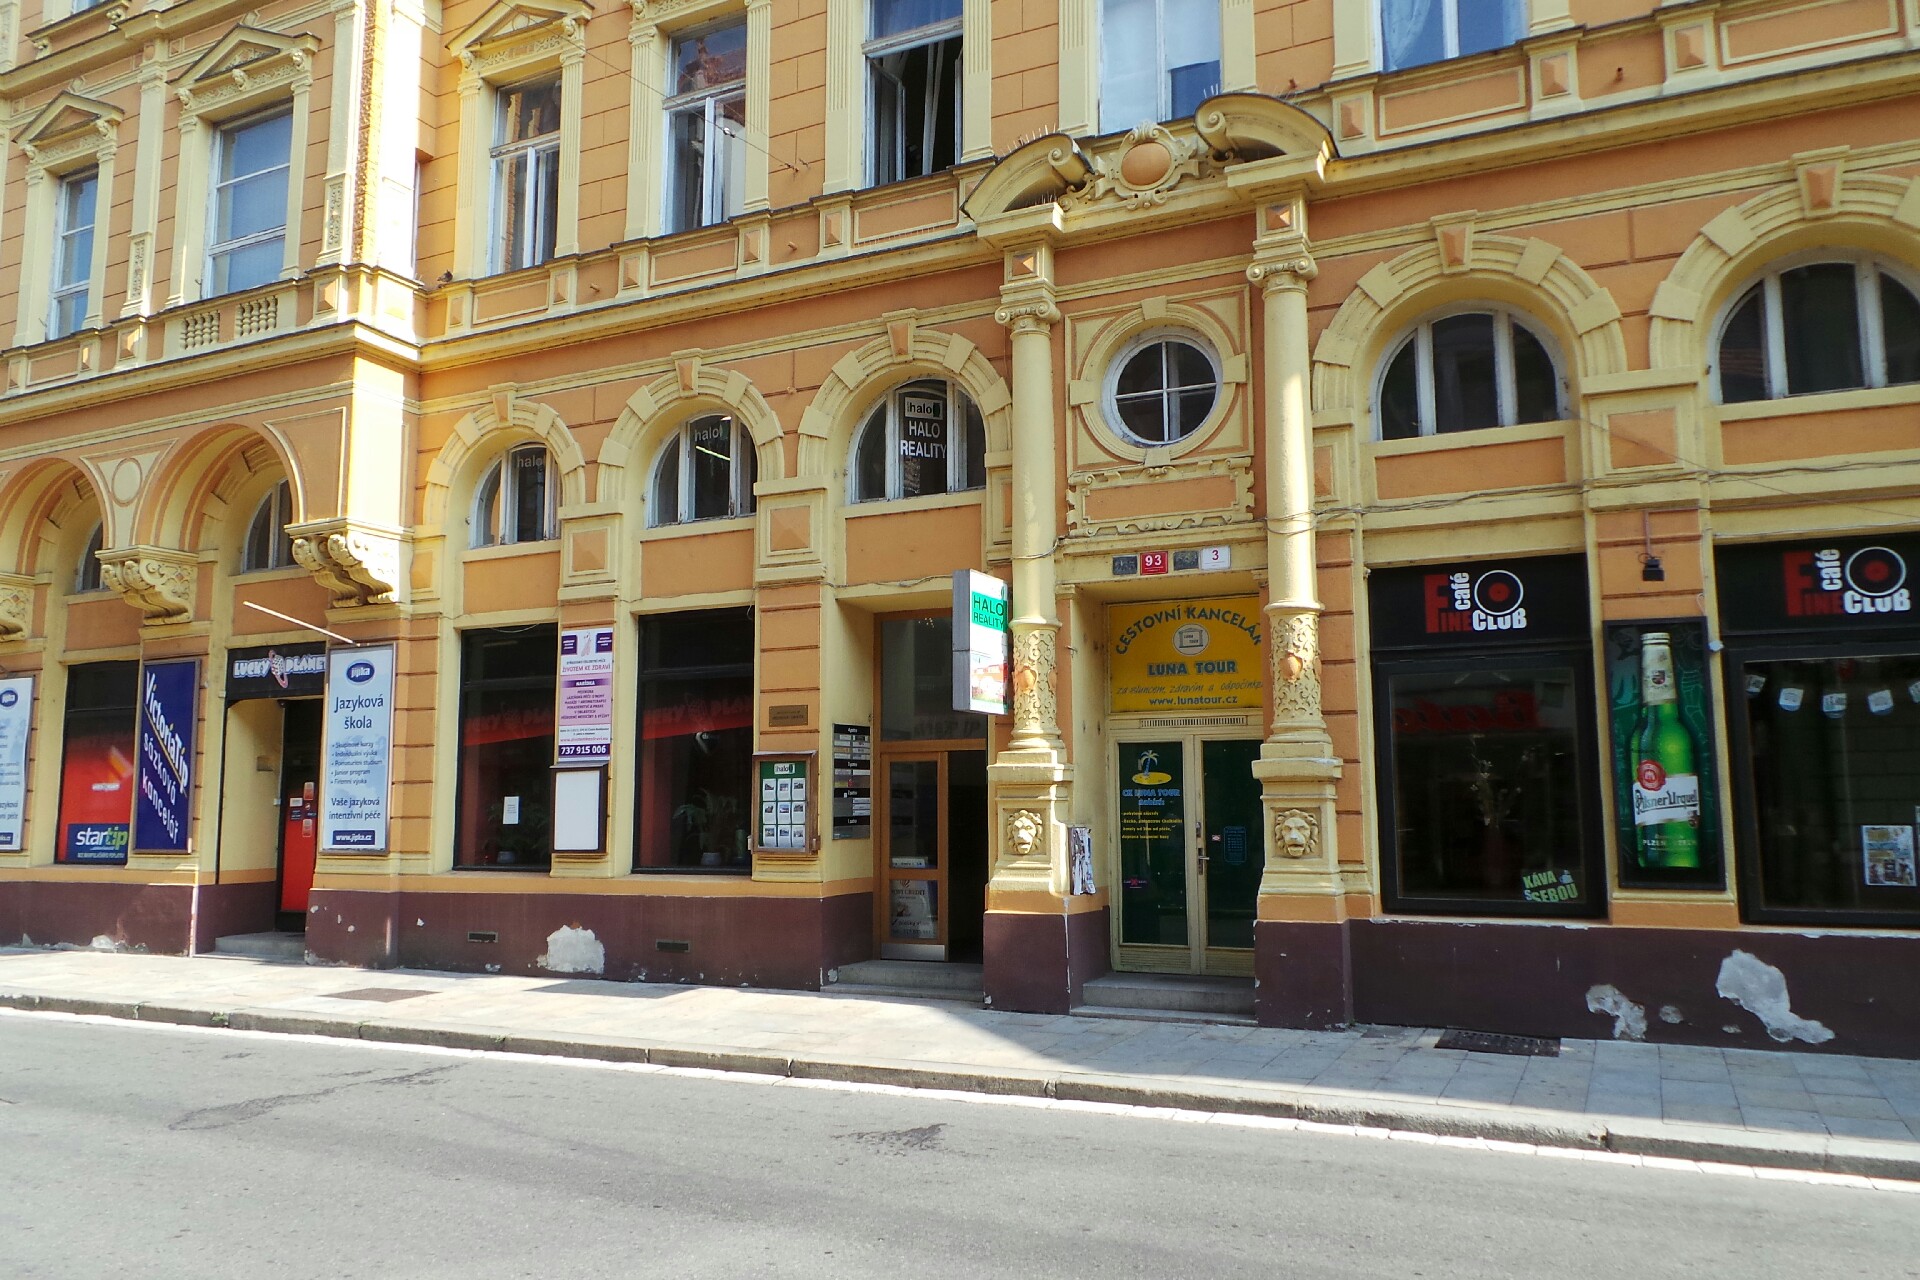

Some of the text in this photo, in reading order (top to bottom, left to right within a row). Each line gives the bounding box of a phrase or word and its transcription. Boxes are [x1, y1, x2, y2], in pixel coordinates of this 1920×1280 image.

[909, 402, 932, 414] halo
[695, 426, 719, 442] halo
[909, 420, 940, 438] HALO
[900, 439, 947, 459] REALITY
[517, 454, 543, 468] halo
[1145, 554, 1162, 566] 93
[1211, 549, 1219, 560] 3
[1814, 548, 1842, 590] café
[1449, 572, 1471, 610] café
[973, 595, 1004, 617] HALO
[1843, 588, 1911, 614] CLUB
[973, 611, 1004, 629] REALITY
[1472, 607, 1527, 631] CLUB
[1116, 604, 1181, 655] CESTOVNÍ
[233, 653, 326, 678] LUCKY PLANE
[1147, 661, 1237, 676] LUNA TOUR
[334, 694, 384, 713] Jazyková
[1148, 695, 1238, 705] www.lunatour.cz
[344, 715, 372, 730] škola
[561, 745, 606, 754] 737 915 006
[1134, 788, 1156, 797] LUNA
[1158, 788, 1181, 797] TOUR
[331, 796, 380, 808] Vaše jazyková
[364, 811, 381, 821] péče
[75, 826, 128, 851] startip
[1522, 870, 1558, 889] KÁVA
[1531, 882, 1579, 903] SEBOU
